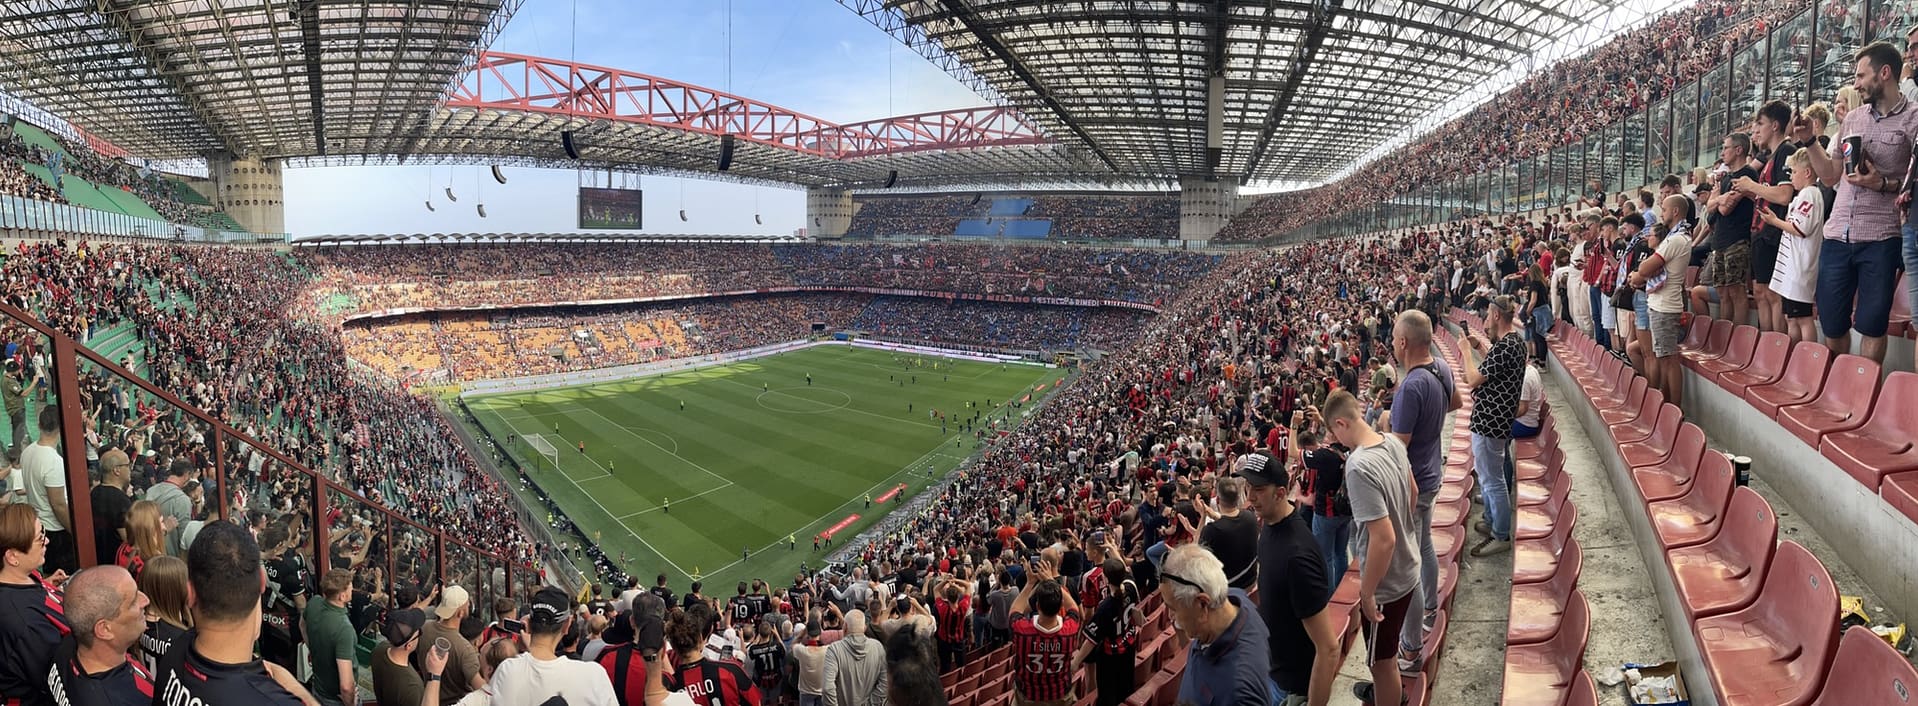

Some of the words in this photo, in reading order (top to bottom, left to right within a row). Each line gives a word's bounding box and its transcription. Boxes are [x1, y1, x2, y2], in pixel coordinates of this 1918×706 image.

[986, 294, 1030, 303] MILANO
[1278, 436, 1289, 450] 10
[734, 603, 748, 618] 19
[141, 633, 172, 656] MOVIĆ
[1025, 653, 1066, 674] 33
[677, 679, 715, 699] IRLO
